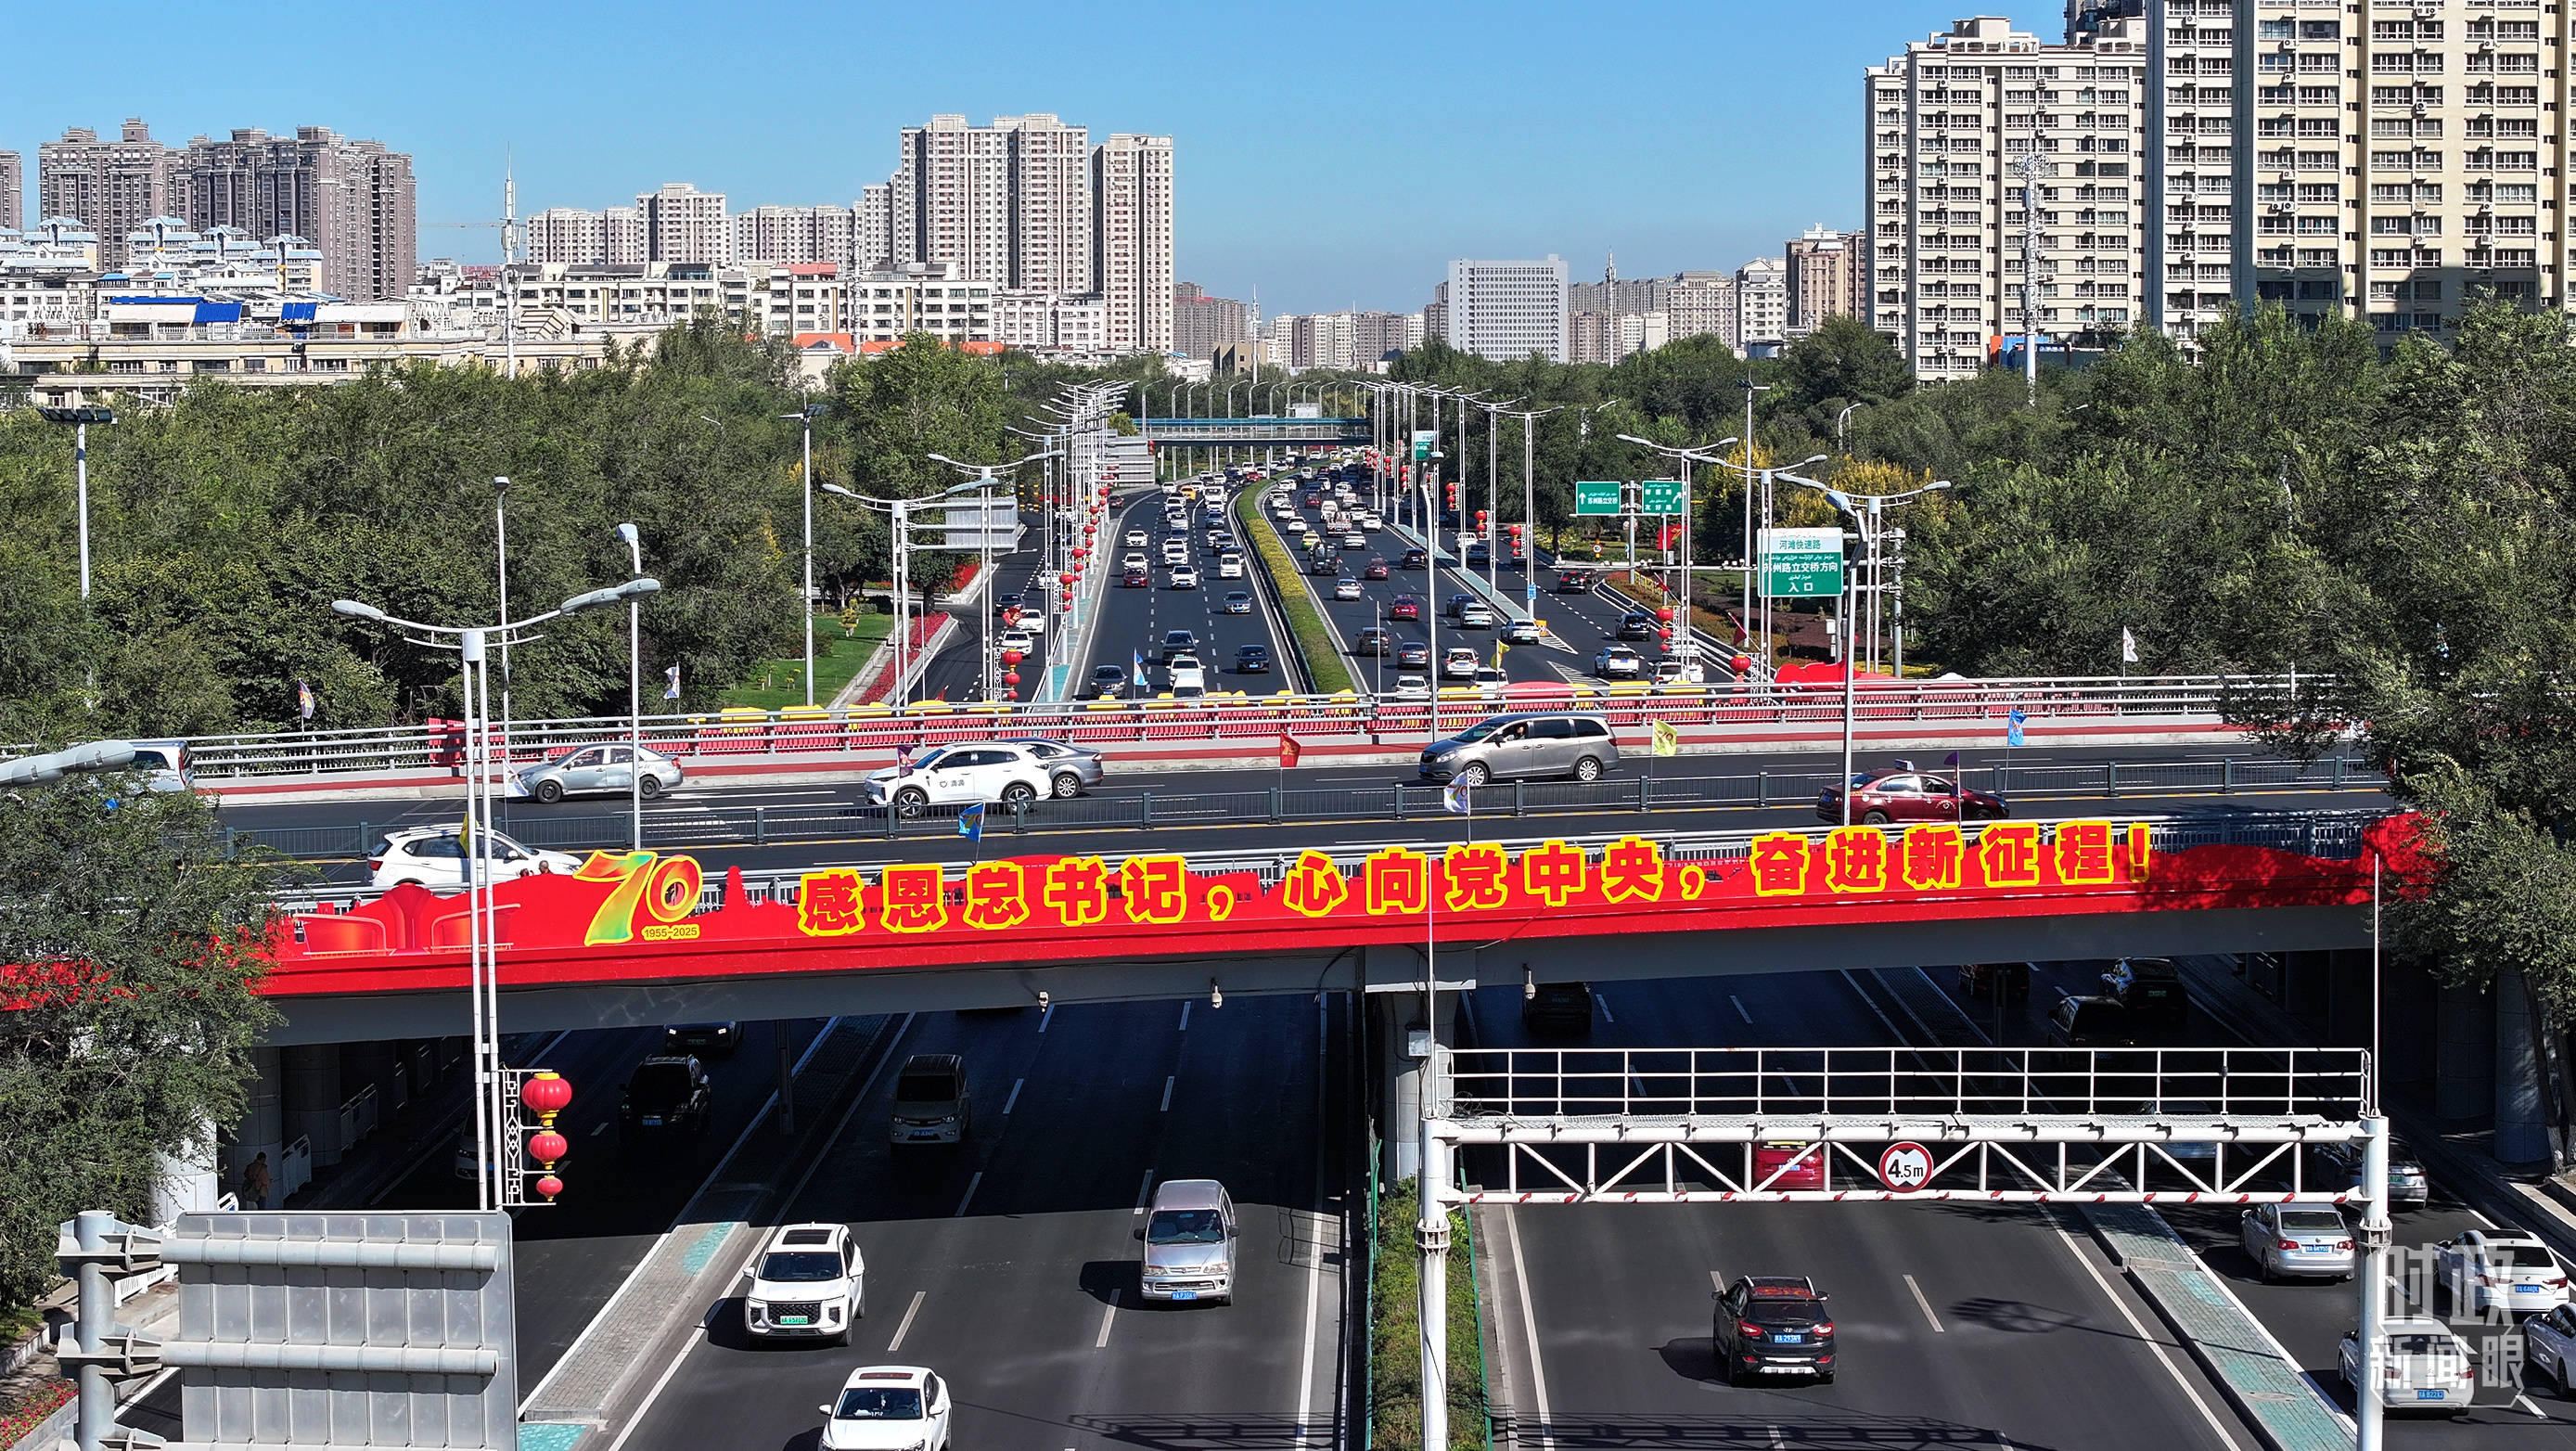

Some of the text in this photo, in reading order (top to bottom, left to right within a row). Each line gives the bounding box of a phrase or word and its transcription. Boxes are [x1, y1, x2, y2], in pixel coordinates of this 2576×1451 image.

[1779, 539, 1821, 550] 河滩快速路
[1788, 582, 1813, 593] 入口
[572, 850, 703, 947] 70
[644, 928, 698, 938] 1955-2025
